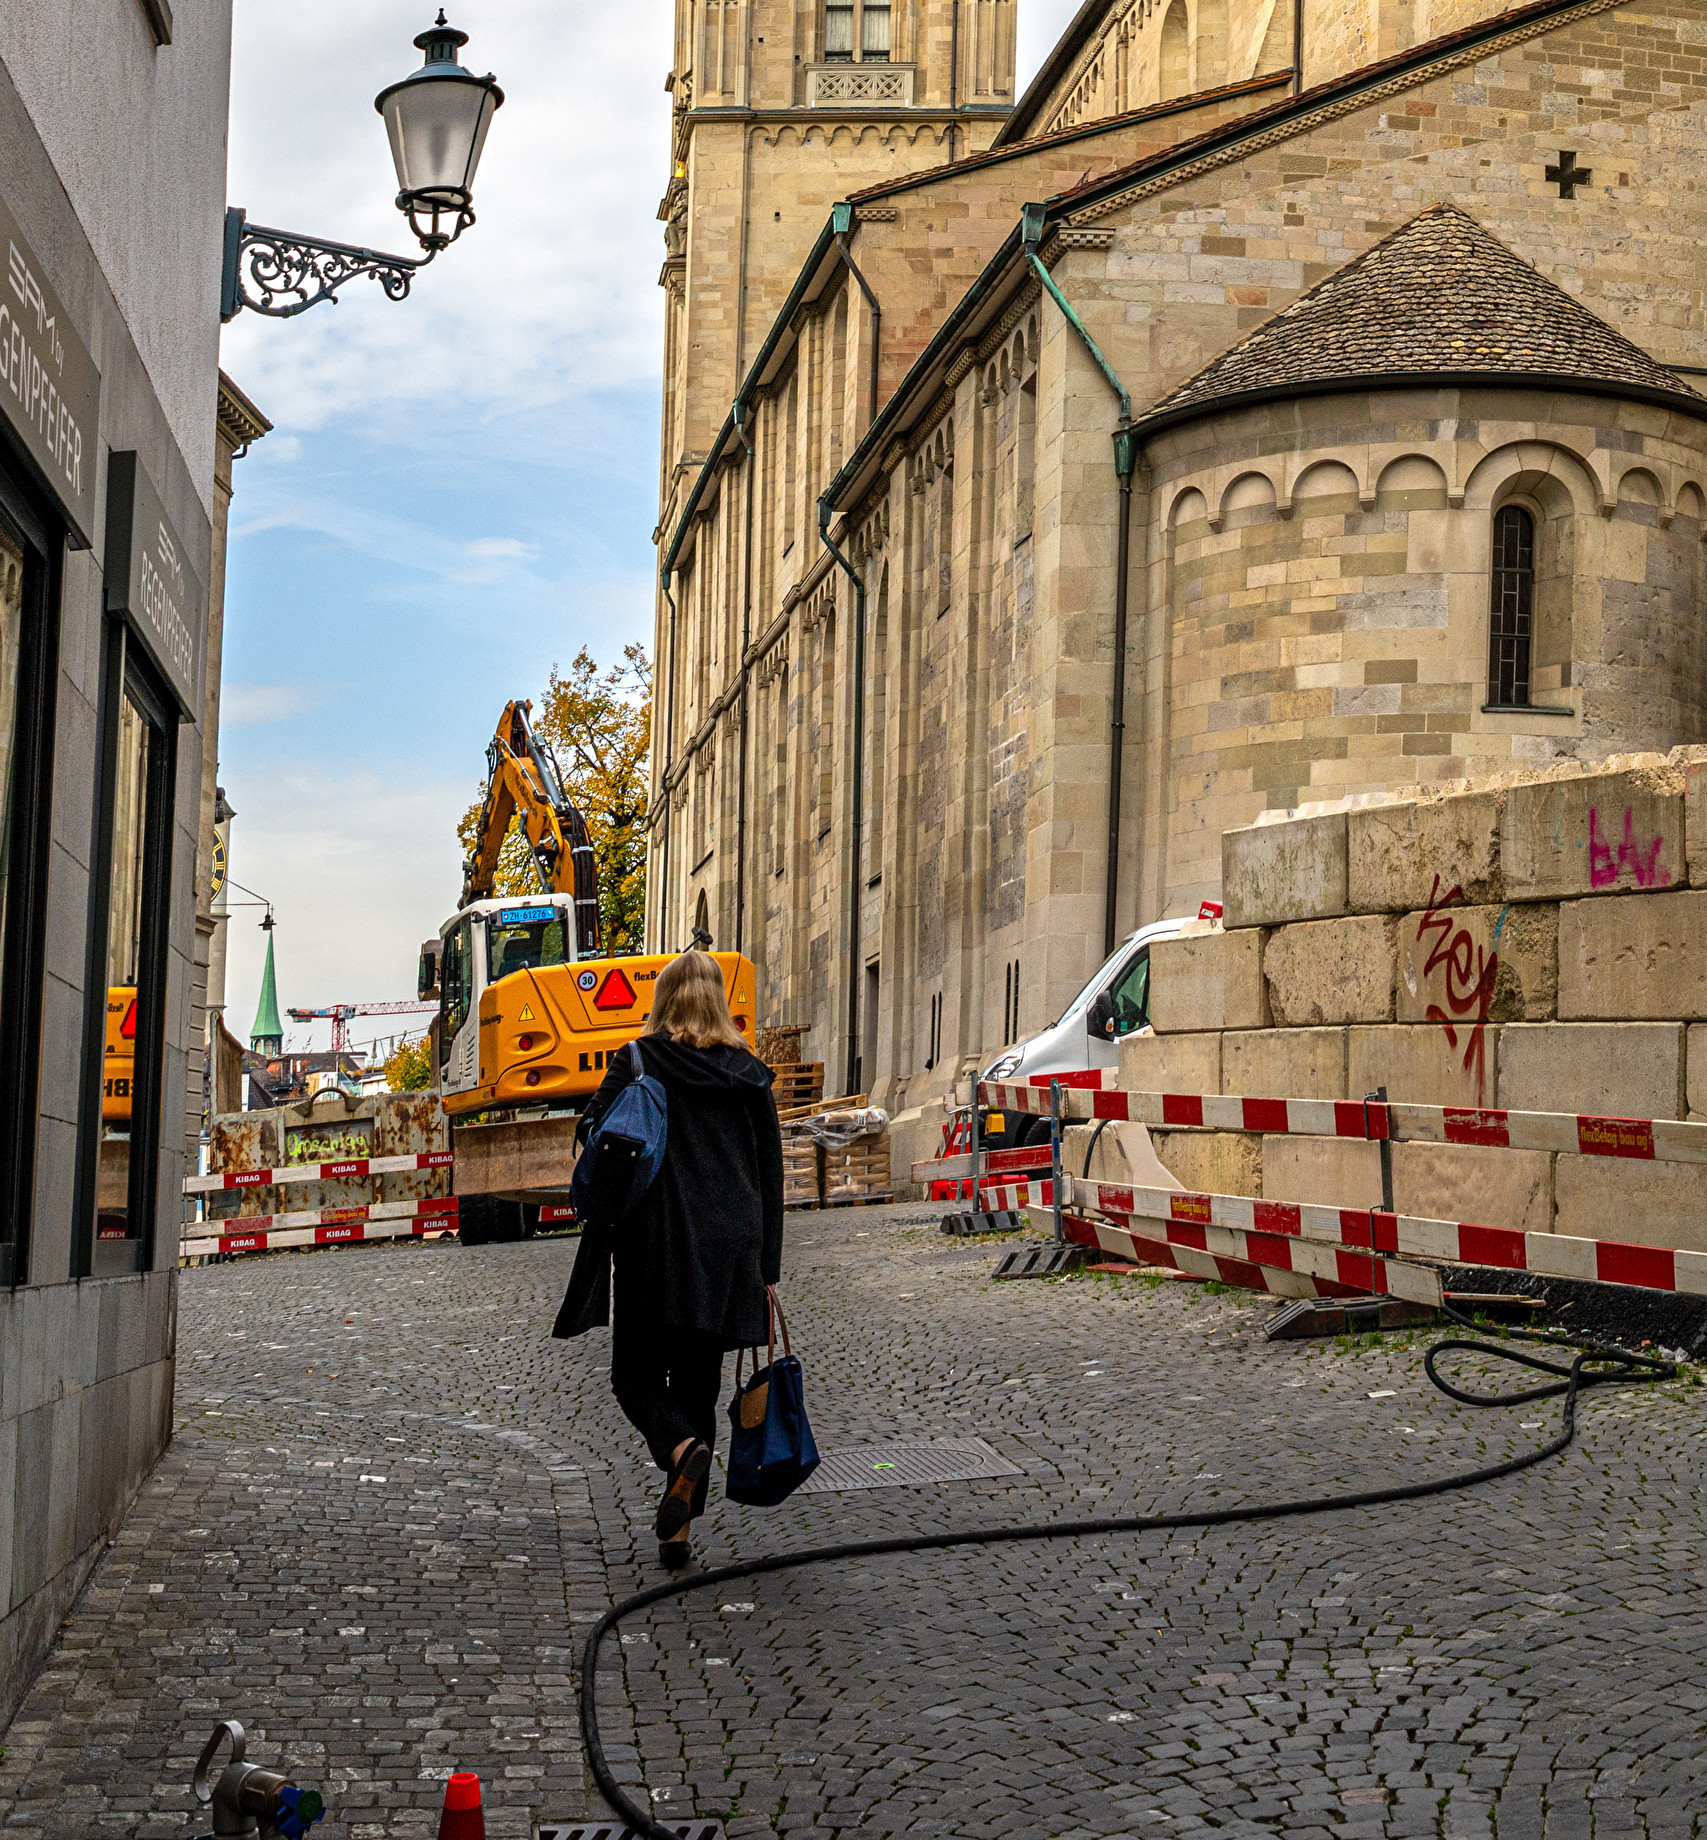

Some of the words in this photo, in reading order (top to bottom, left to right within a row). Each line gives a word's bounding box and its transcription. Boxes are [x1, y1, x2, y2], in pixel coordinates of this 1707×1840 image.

[8, 239, 55, 355] SAM
[56, 329, 64, 377] by
[141, 550, 193, 687] REGENPFEIFER
[582, 976, 593, 985] 30
[1580, 1126, 1618, 1151] flexBelag
[1620, 1129, 1637, 1147] bau
[1637, 1134, 1648, 1151] ag
[287, 1131, 369, 1158] Umschlag
[429, 1155, 453, 1164] KIBAG
[332, 1164, 357, 1174] KIBAG
[235, 1174, 260, 1183] KIBAG
[553, 1208, 576, 1217] KIBA
[423, 1219, 449, 1229] KIBAG
[326, 1229, 351, 1238] KIBAG
[230, 1238, 255, 1248] KIBAG
